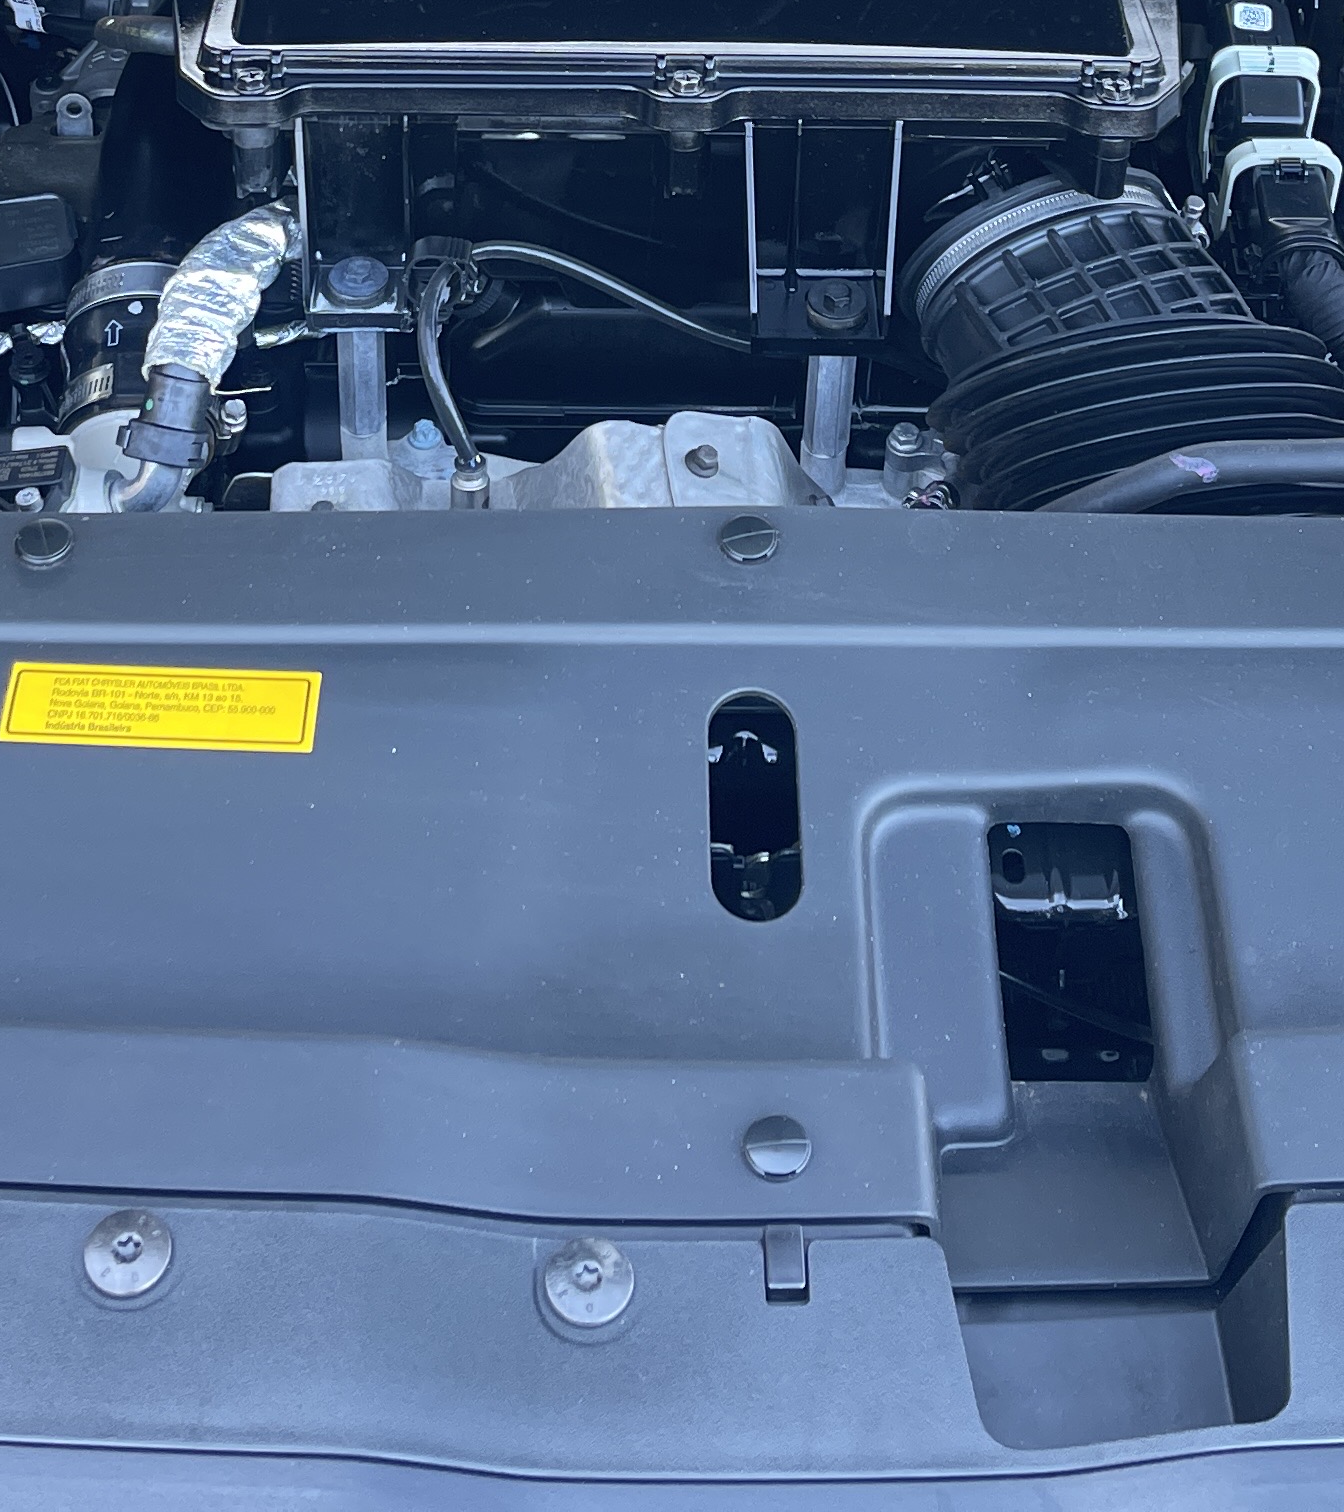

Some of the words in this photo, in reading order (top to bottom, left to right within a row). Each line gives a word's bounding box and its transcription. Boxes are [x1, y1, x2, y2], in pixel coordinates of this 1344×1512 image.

[72, 677, 91, 687] FIAT
[91, 678, 136, 689] CHRYSLER
[191, 682, 219, 691] BRASIL
[51, 687, 89, 697] Rodovia
